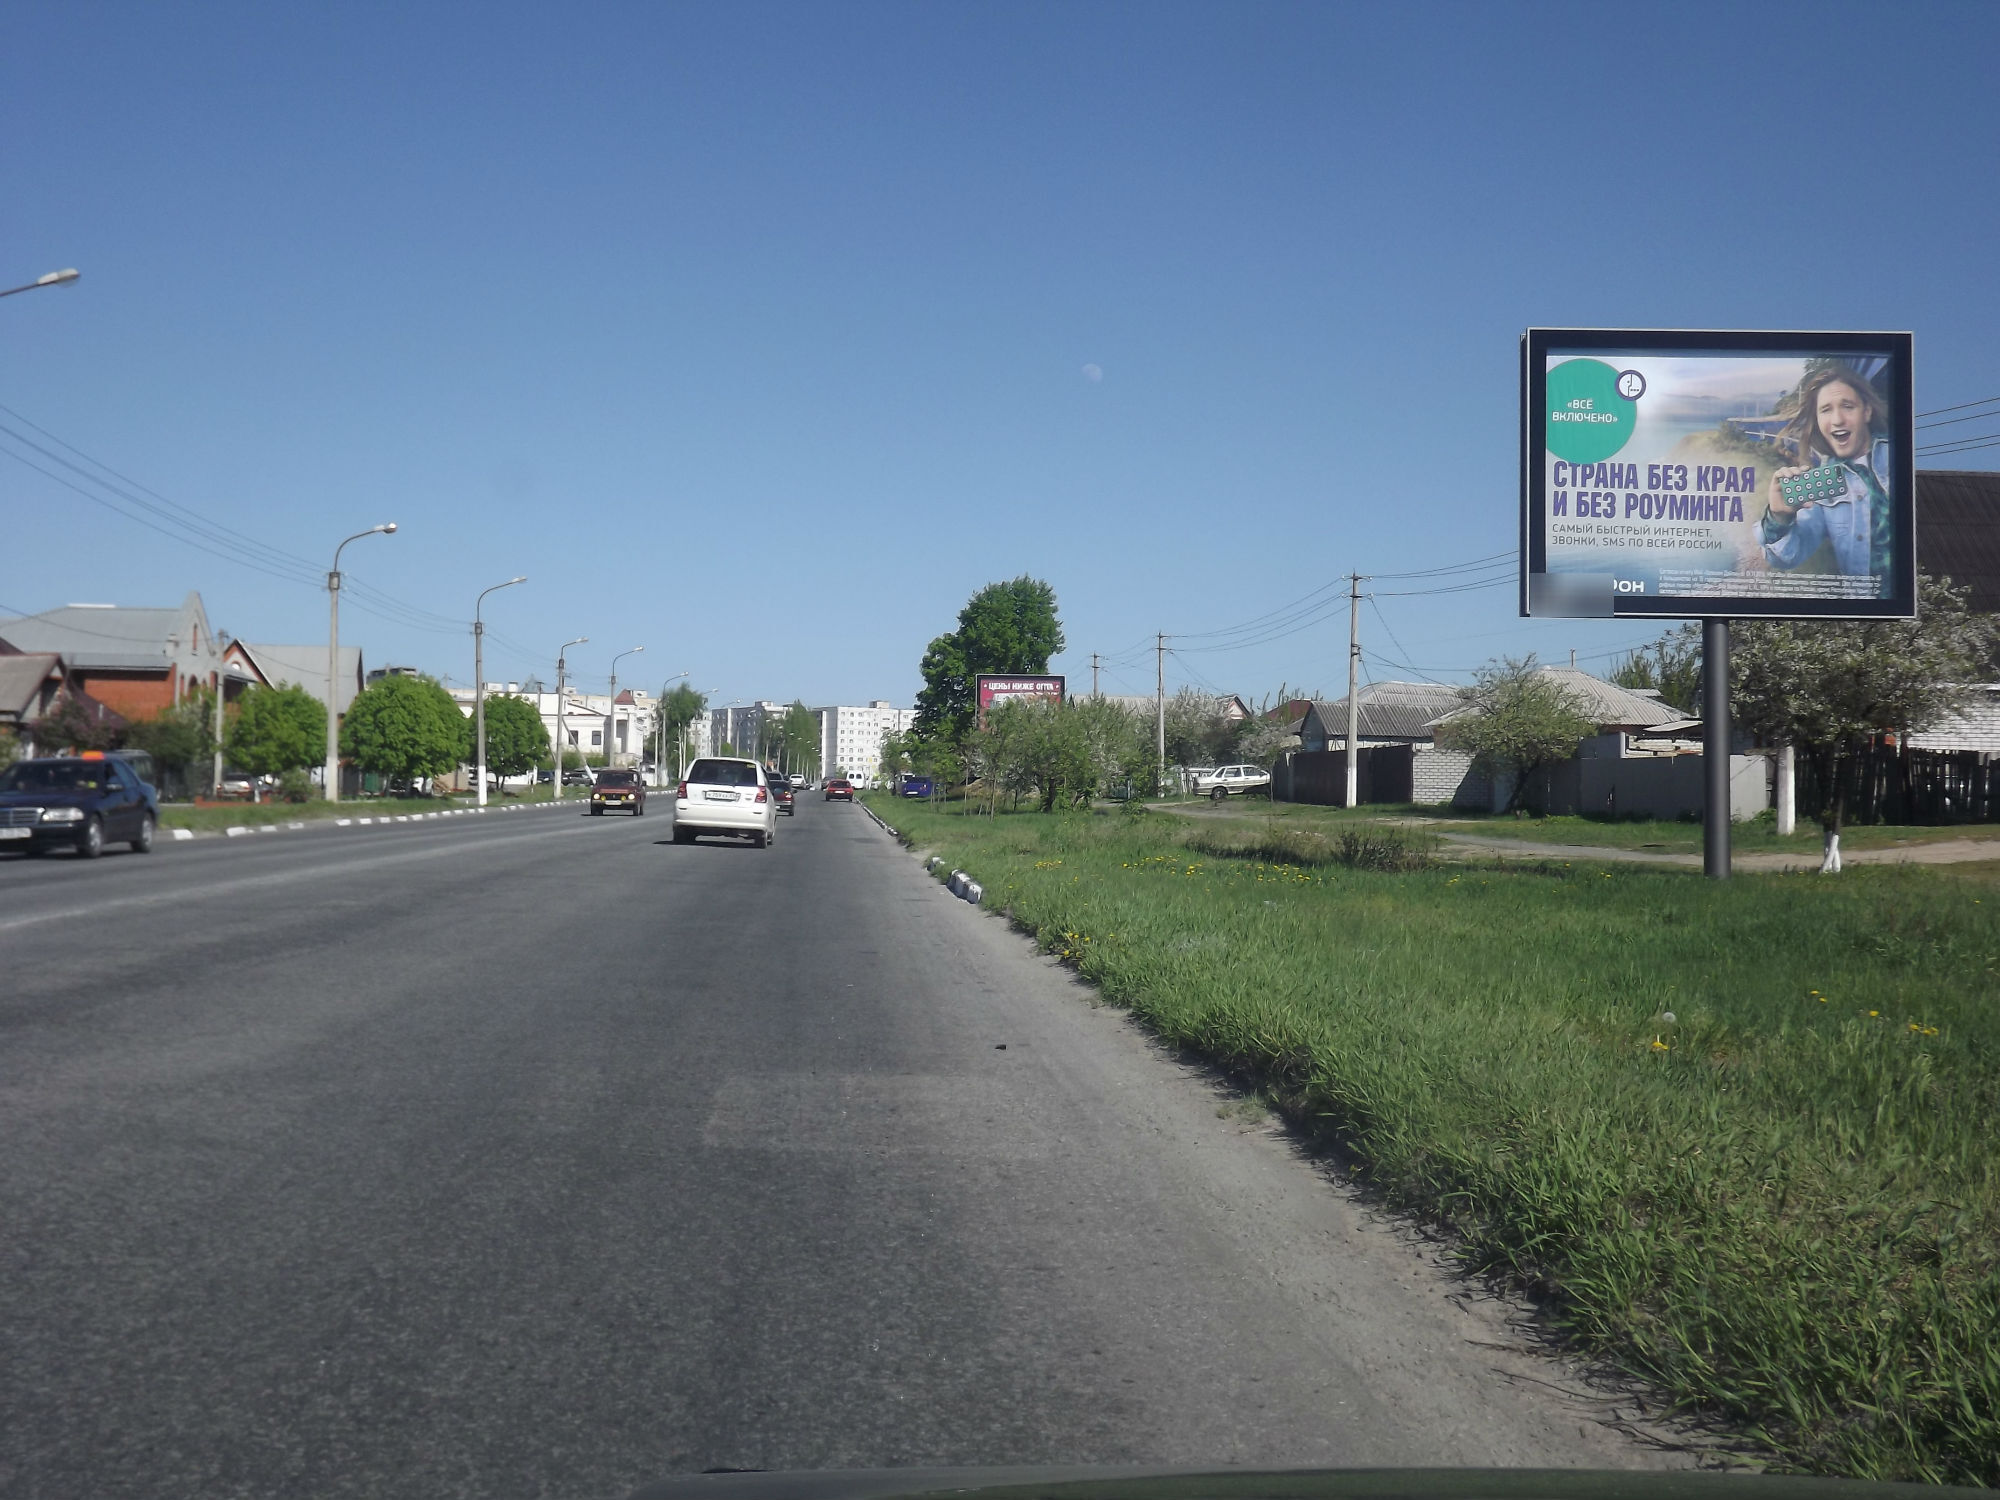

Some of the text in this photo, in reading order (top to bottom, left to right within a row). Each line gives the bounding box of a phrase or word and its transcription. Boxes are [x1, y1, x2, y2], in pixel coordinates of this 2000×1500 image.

[1552, 411, 1618, 424] ВКЛЮЧЕНО»
[1553, 461, 1756, 493] СТРАНА БЕЗ КРАЯ
[1552, 490, 1744, 523] И БЕЗ РОУМИНГА
[1552, 523, 1593, 534] САМЫЙ
[1596, 524, 1650, 536] БЫСТРЫЙ
[1552, 535, 1722, 550] ЗВОНКИ, SMS ПО ВСЕЙ РОССИИ
[988, 682, 1011, 690] ЦЕНЫ
[1012, 682, 1035, 690] НИЖЕ
